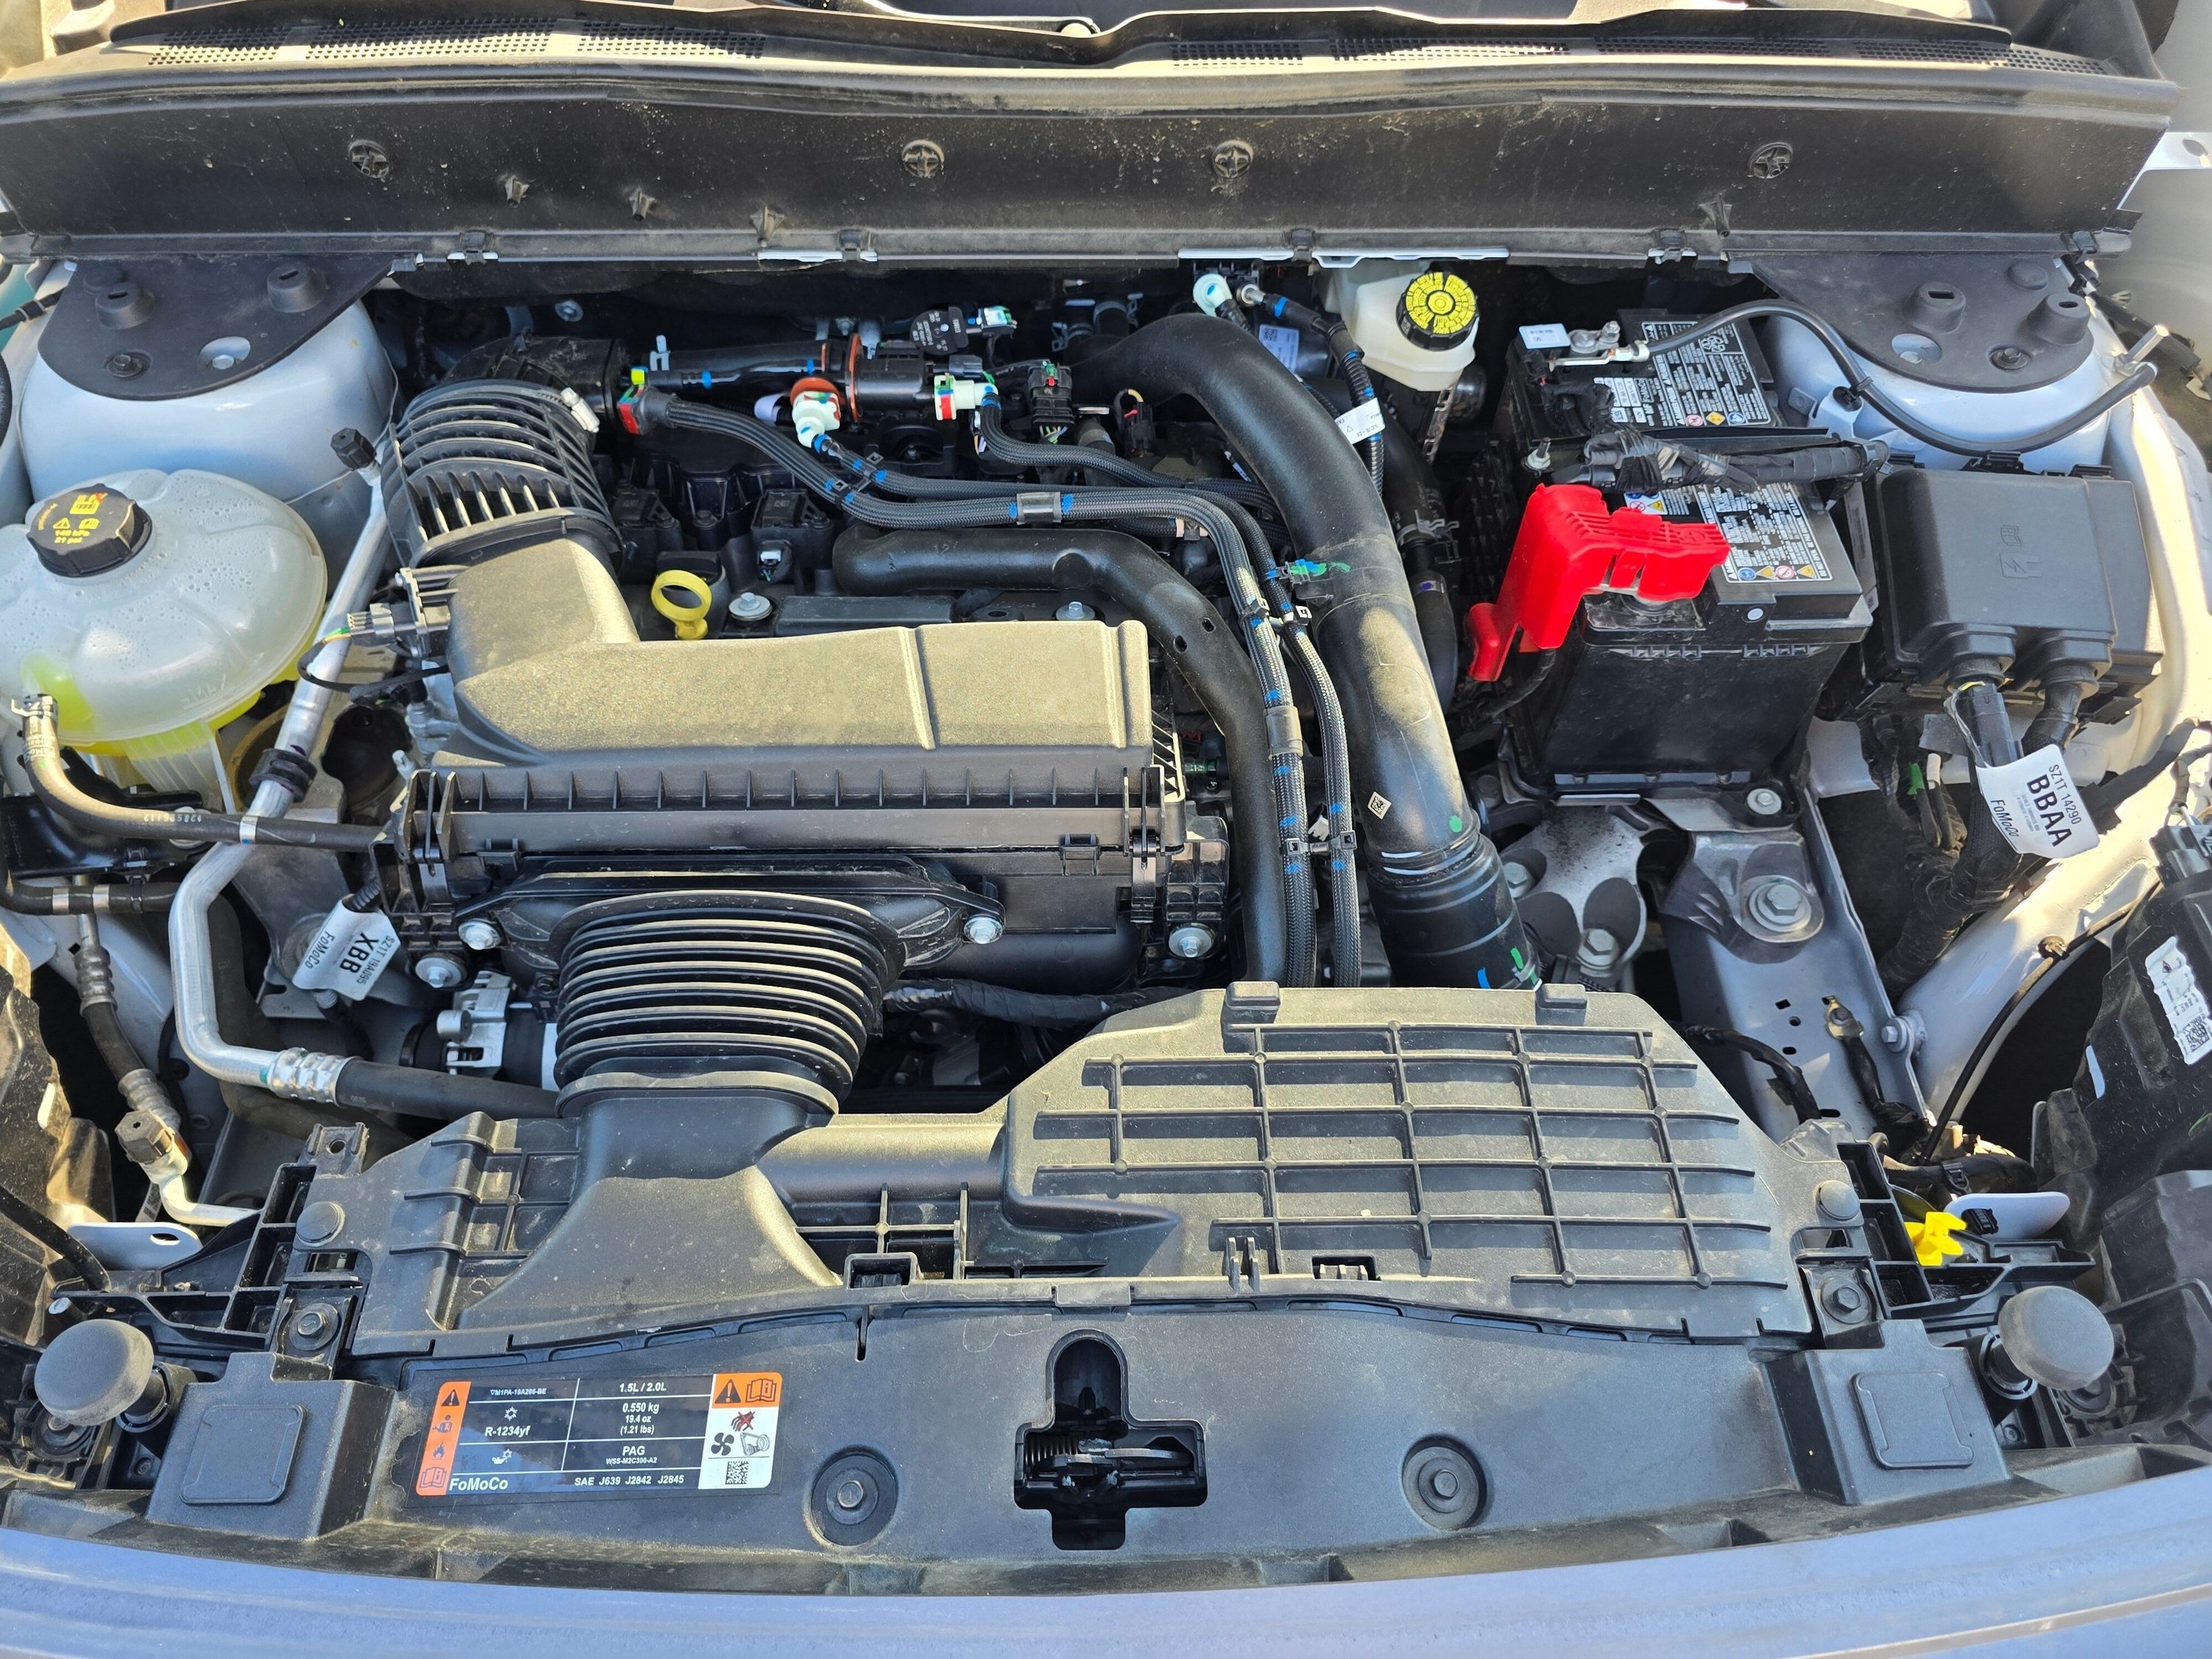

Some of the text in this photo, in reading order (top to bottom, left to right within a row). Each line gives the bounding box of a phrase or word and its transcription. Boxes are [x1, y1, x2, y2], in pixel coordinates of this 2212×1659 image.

[2049, 764, 2081, 825] SZ1T 14290
[2027, 774, 2073, 847] BBAA
[1991, 799, 2020, 837] FoMoCo
[305, 931, 335, 969] FoMoCo
[340, 932, 379, 974] XBB
[619, 1381, 667, 1394] 1.5L / 2.0L
[622, 1402, 659, 1415] 0.550 kg
[625, 1414, 641, 1424] 19.4
[484, 1425, 531, 1438] R-1234yf
[620, 1424, 655, 1436] (1.21 lbs)
[622, 1445, 645, 1456] PAG
[605, 1456, 658, 1466] WSS-M2C300-A2
[448, 1476, 509, 1491] FoMoCo
[574, 1475, 684, 1486] SAE J639 J2842 J2845
